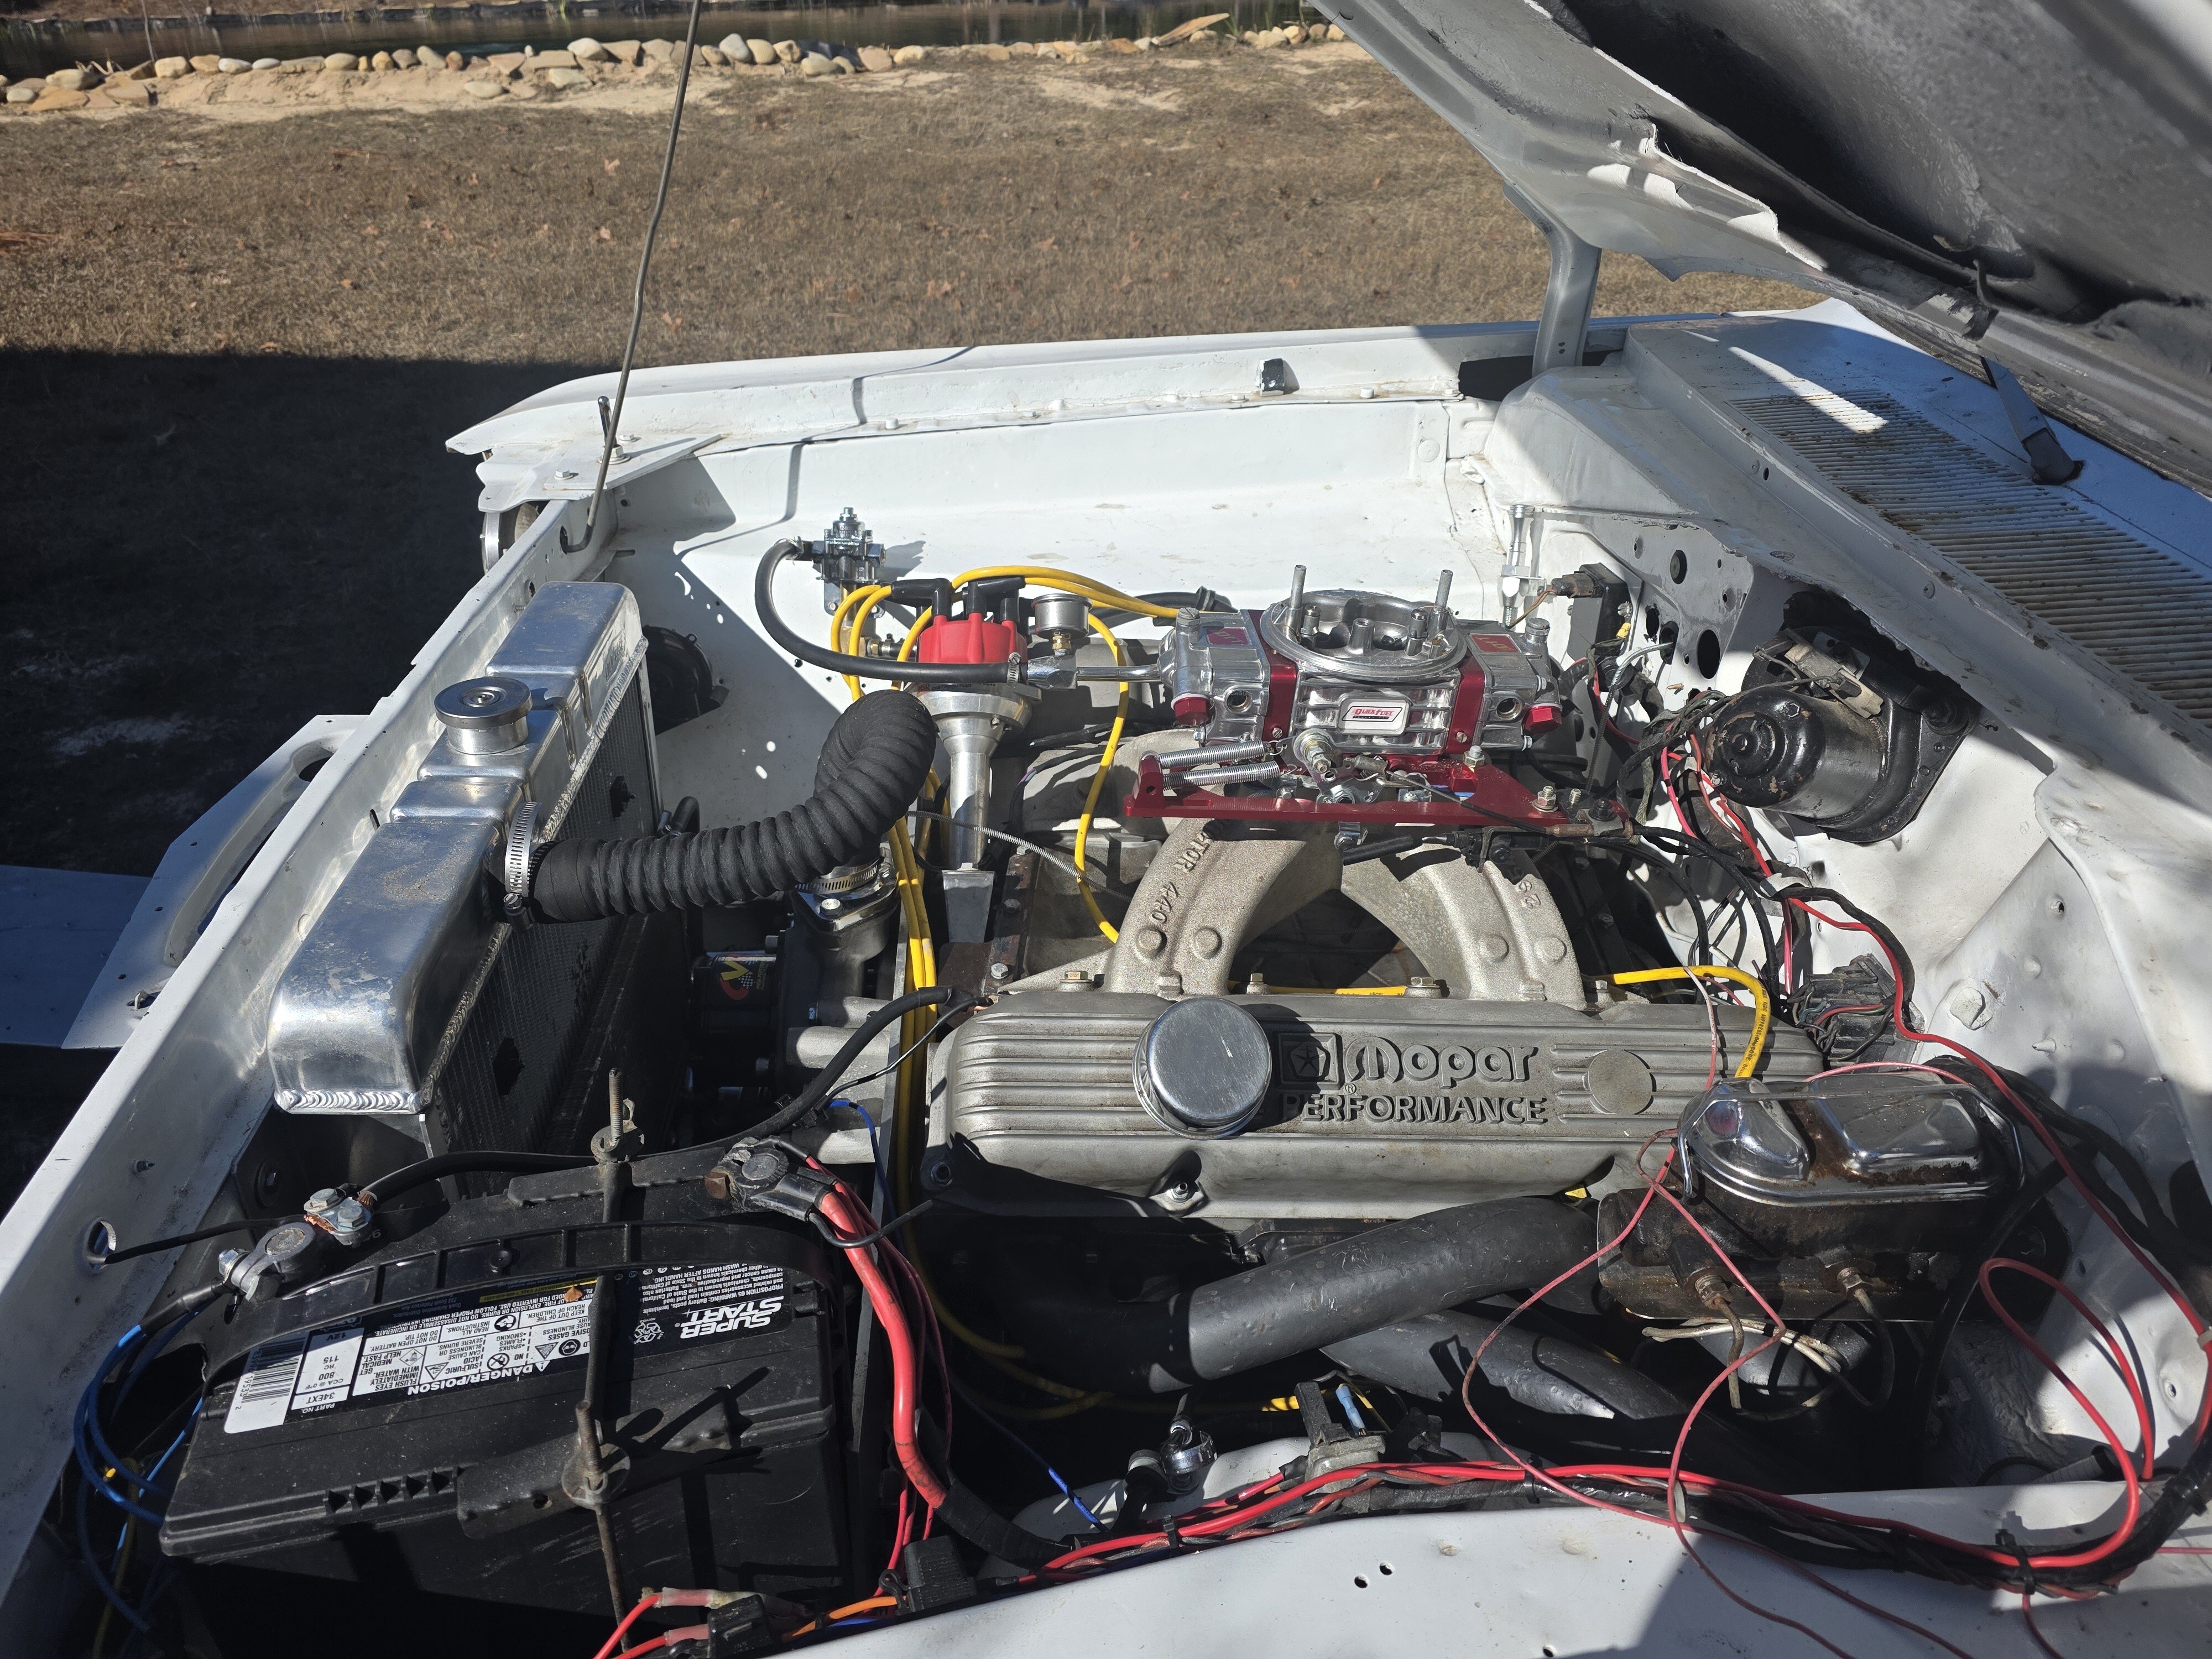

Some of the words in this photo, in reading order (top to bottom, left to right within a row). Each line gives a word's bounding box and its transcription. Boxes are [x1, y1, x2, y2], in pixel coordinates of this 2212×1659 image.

[1150, 881, 1180, 925] 440
[1282, 1093, 1548, 1125] PERFORMANCE
[684, 1269, 701, 1277] AFTER
[703, 1266, 721, 1274] HANDS
[721, 1266, 747, 1276] chemicals
[653, 1272, 682, 1283] HANDLING.
[697, 1275, 729, 1286] reproductive
[752, 1271, 782, 1282] compounds,
[723, 1278, 749, 1287] chemicals
[655, 1285, 679, 1294] Batteries
[701, 1289, 719, 1297] contain
[722, 1283, 752, 1293] accessories
[746, 1283, 782, 1295] PROPOSITION
[512, 1297, 538, 1307] INVERTED
[688, 1296, 706, 1306] Battery
[708, 1292, 736, 1302] WARNING:
[421, 1304, 447, 1314] Automotive
[476, 1305, 497, 1314] FOLLOW
[510, 1302, 540, 1312] EXPLOSION
[567, 1303, 585, 1312] REACH
[643, 1304, 668, 1314] terminals
[681, 1295, 783, 1328] START
[421, 1313, 450, 1323] CHARGING
[451, 1309, 473, 1318] PROPER
[481, 1310, 500, 1318] BURNS.
[527, 1308, 555, 1319] CHILDREN.
[418, 1317, 456, 1329] DISASSEMBLE
[447, 1320, 489, 1333] INSTRUCTIONS.
[681, 1311, 771, 1340] SUPER
[375, 1325, 408, 1336] INCINERATE.
[542, 1324, 574, 1335] BLINDNESS
[326, 1332, 345, 1341] 12V
[497, 1332, 523, 1341] SMOKING
[548, 1331, 568, 1340] GASES
[438, 1342, 459, 1350] BURNS.
[461, 1337, 482, 1345] SEVERE
[500, 1337, 522, 1346] FLAMES
[371, 1342, 396, 1352] BATTERY.
[448, 1343, 481, 1354] BLINDNESS
[499, 1343, 521, 1352] SPARKS
[323, 1355, 338, 1364] 115
[364, 1354, 382, 1363] FAST.
[384, 1350, 401, 1359] HELP
[448, 1352, 466, 1360] CAUSE
[463, 1355, 479, 1364] ACID
[362, 1358, 392, 1369] MEDICAL
[445, 1363, 478, 1374] SULFURIC
[374, 1368, 399, 1378] WATER.
[402, 1365, 419, 1374] WITH
[319, 1371, 334, 1380] 800
[370, 1371, 418, 1385] IMMEDIATELY
[408, 1364, 532, 1395] DANGER/POISON
[239, 1375, 252, 1396] 19533
[375, 1382, 392, 1391] EYES
[395, 1378, 416, 1387] FLUSH
[306, 1391, 335, 1404] 34EXT
[315, 1402, 335, 1411] PART
